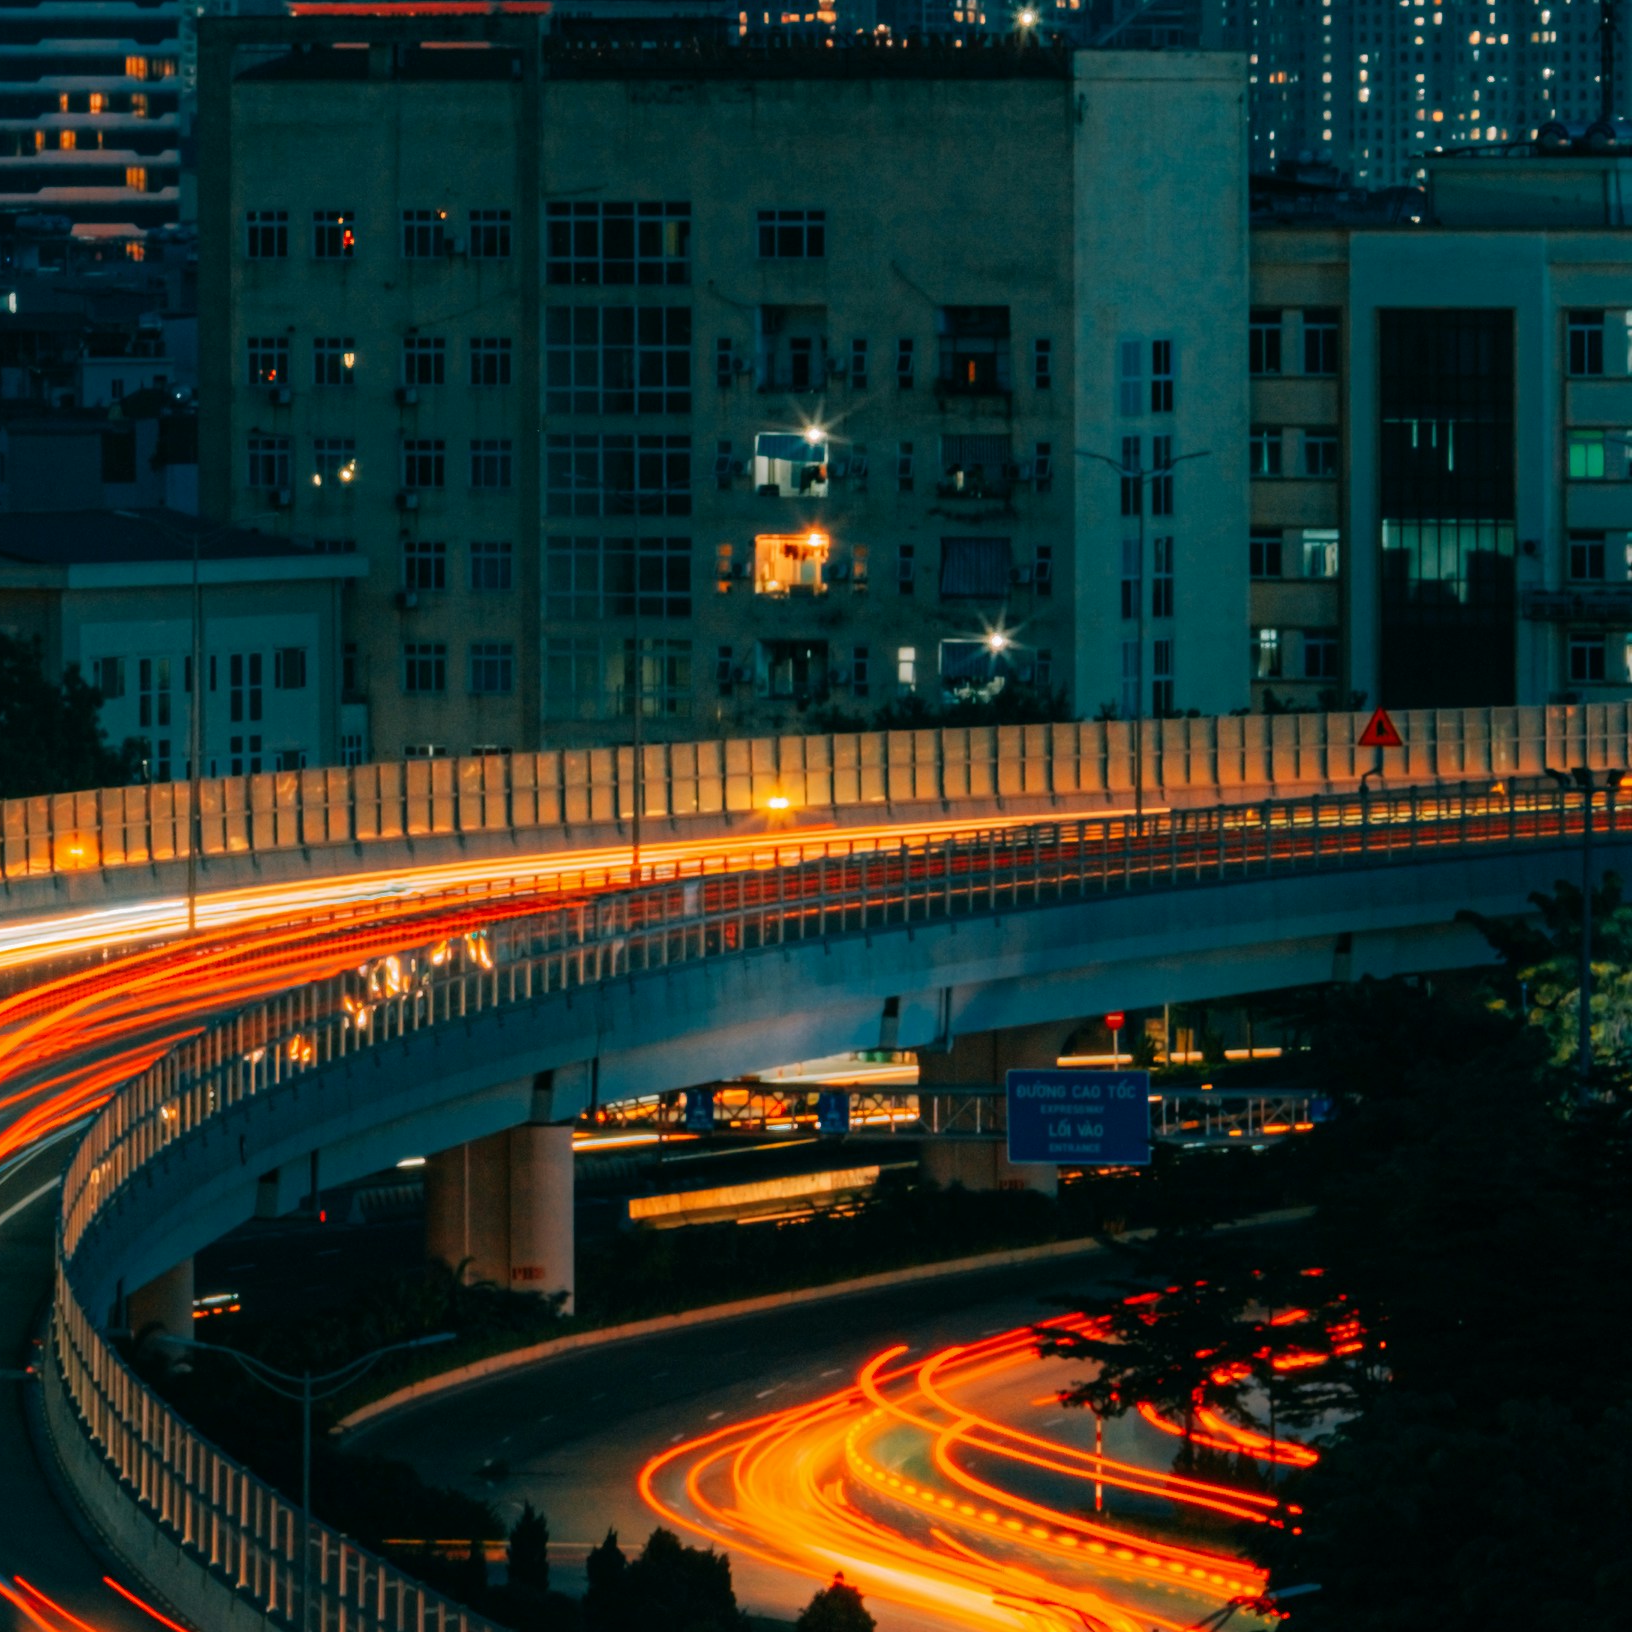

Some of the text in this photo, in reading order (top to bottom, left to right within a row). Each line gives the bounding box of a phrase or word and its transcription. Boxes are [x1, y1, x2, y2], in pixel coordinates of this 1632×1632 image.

[1071, 1084, 1101, 1099] CAO
[1107, 1078, 1137, 1099] TỐC
[1076, 1120, 1104, 1138] VÀO
[1048, 1142, 1101, 1154] ENTRANCE
